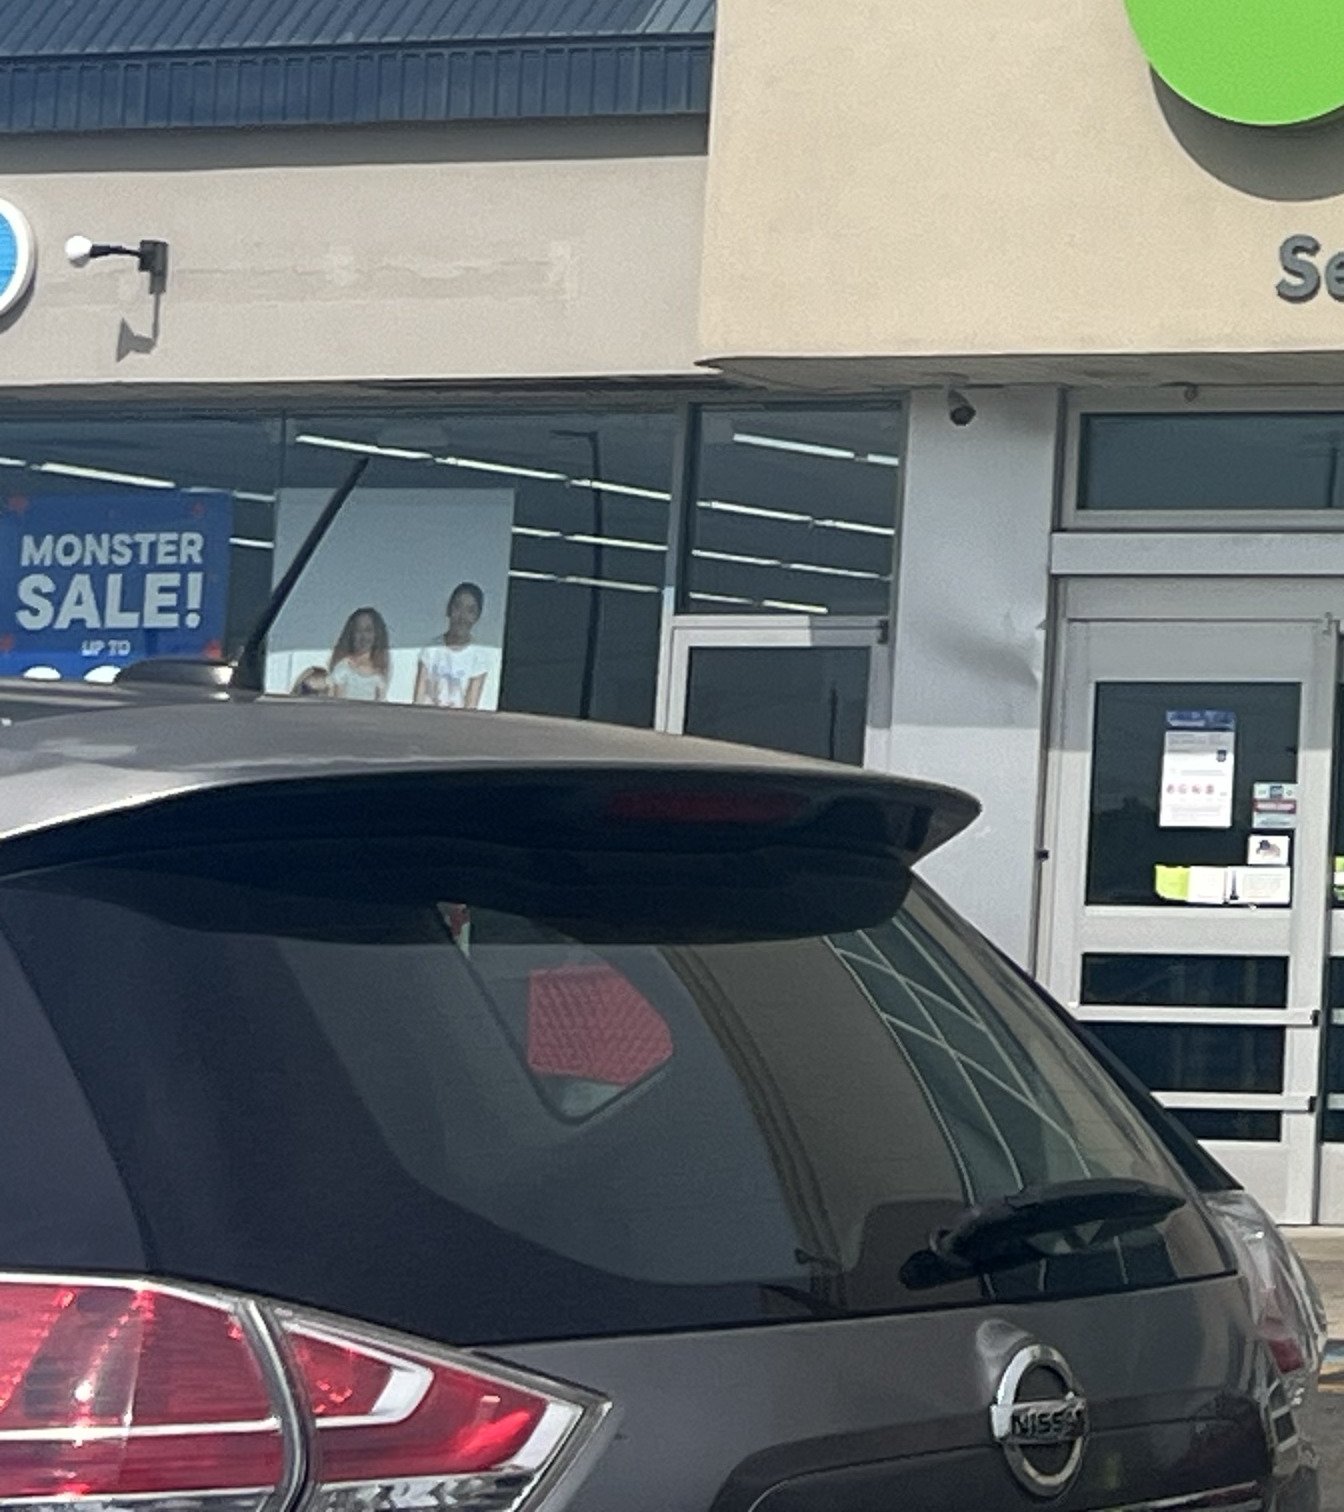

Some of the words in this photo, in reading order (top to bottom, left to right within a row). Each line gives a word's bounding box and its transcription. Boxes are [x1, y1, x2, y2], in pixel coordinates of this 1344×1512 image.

[20, 531, 205, 567] MONSTER
[15, 571, 204, 631] SALE!
[81, 639, 105, 657] UP
[108, 639, 131, 656] TO
